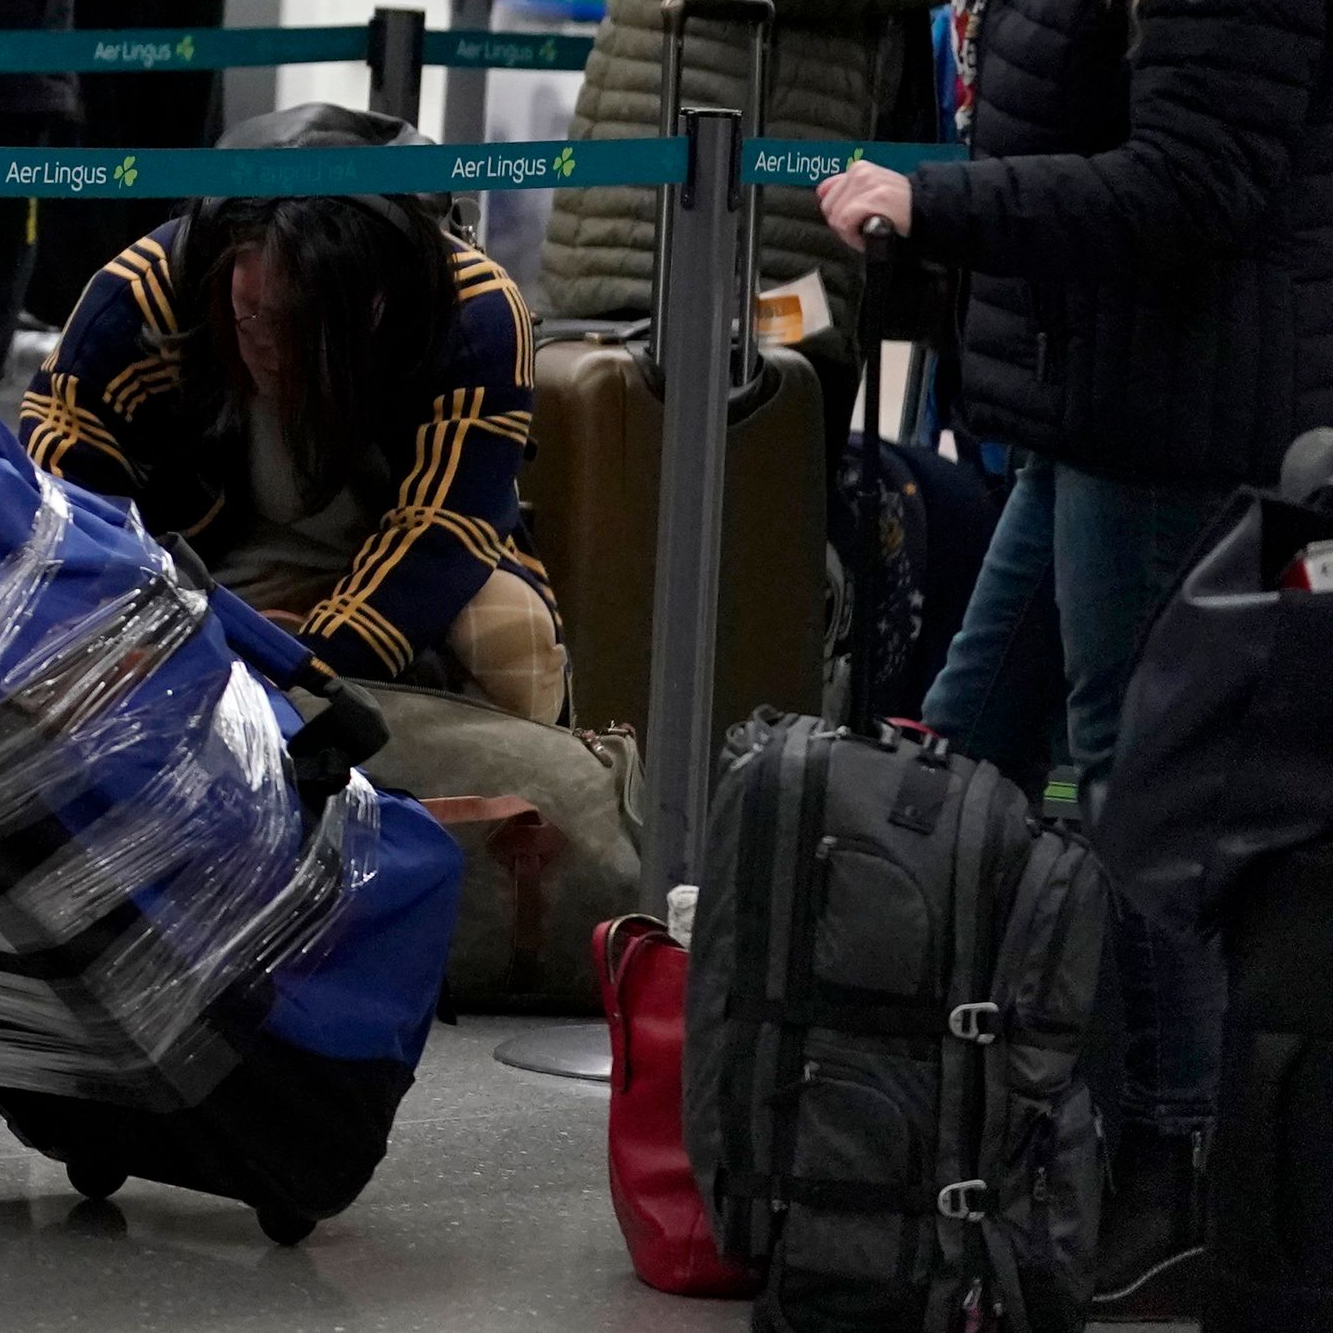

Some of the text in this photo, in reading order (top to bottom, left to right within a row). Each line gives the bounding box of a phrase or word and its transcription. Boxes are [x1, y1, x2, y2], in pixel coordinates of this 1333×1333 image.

[94, 40, 172, 68] Aer Lingus
[5, 161, 107, 192] Aer Lingus
[451, 154, 547, 184] Aer Lingus
[754, 150, 841, 181] Aer Lingus
